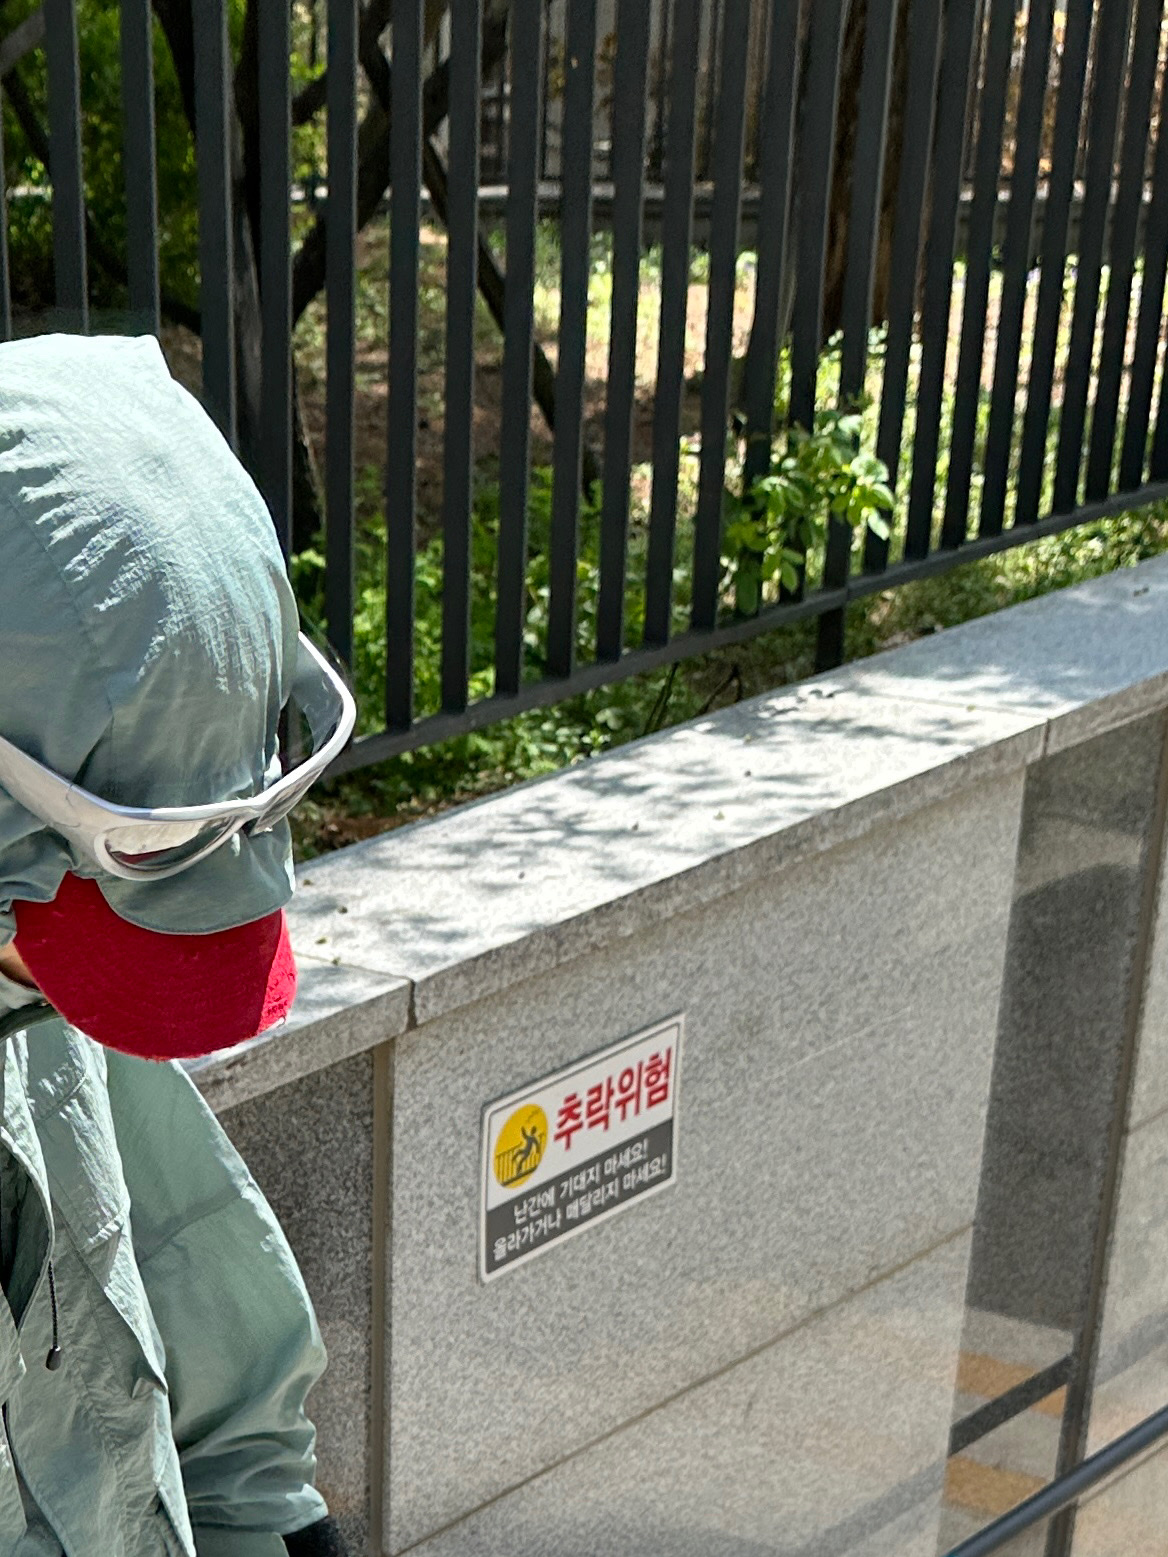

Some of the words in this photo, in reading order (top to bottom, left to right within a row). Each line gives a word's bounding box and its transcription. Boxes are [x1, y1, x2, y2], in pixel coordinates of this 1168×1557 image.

[553, 1046, 672, 1150] 추락위험
[493, 1210, 561, 1261] 올라가거나
[566, 1177, 619, 1220] 매달리지
[623, 1153, 667, 1190] 마세요!
[514, 1186, 555, 1225] 난간에
[560, 1162, 600, 1198] 기대지
[604, 1138, 649, 1176] 마세요!
